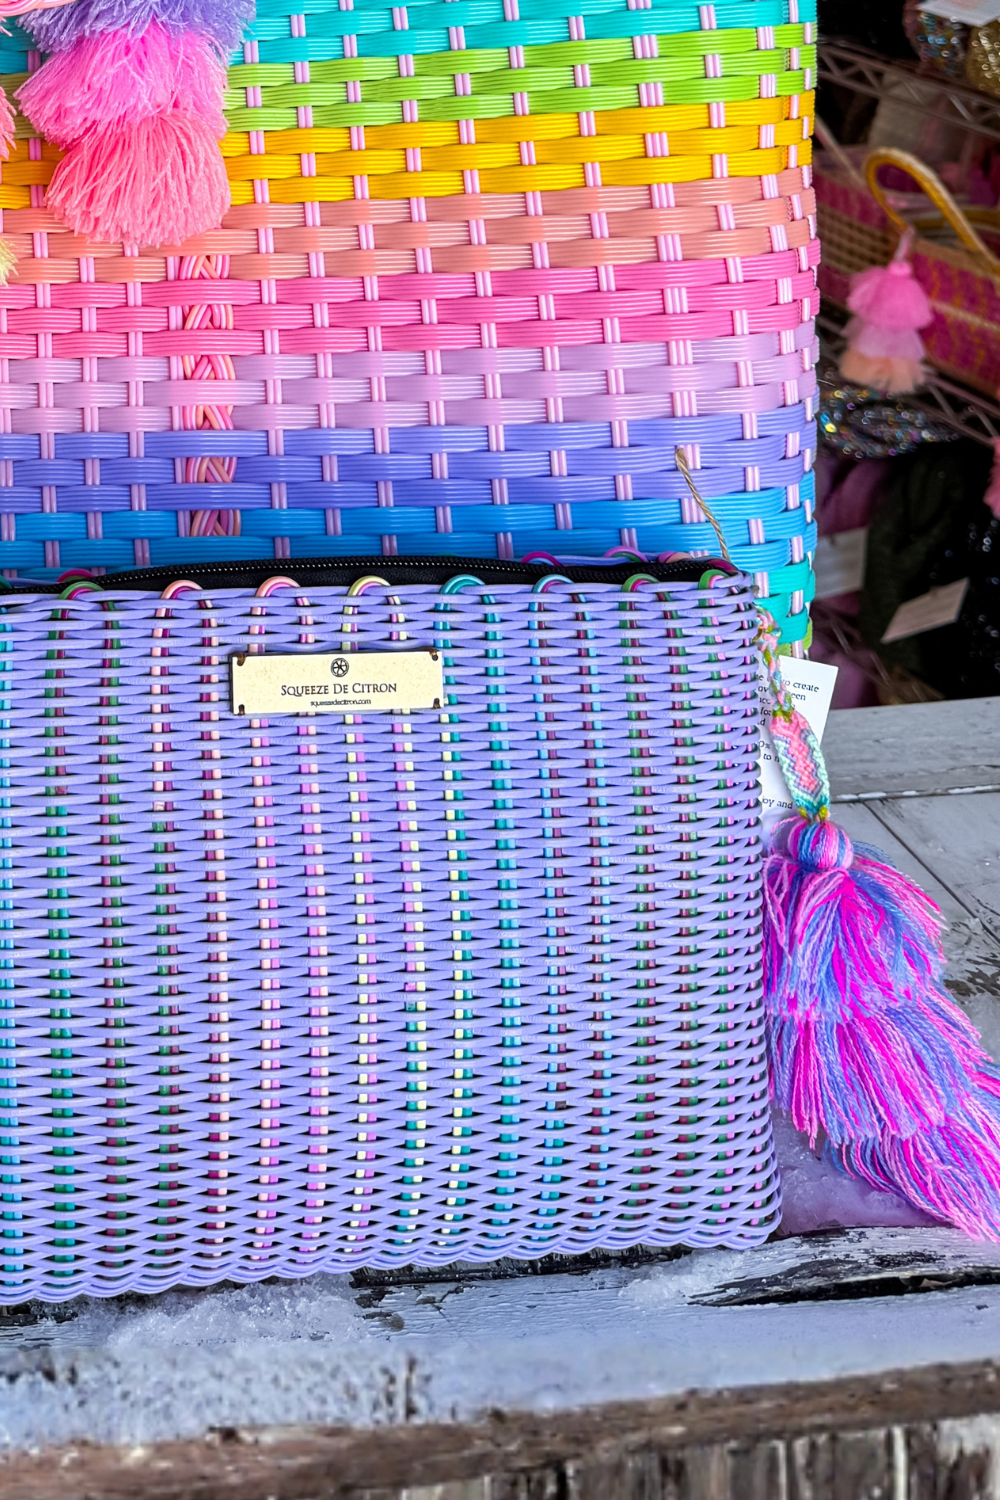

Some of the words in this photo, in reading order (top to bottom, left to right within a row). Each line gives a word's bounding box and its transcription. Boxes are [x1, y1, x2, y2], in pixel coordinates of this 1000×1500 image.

[281, 684, 329, 697] SQUEEZE
[333, 683, 349, 695] DE
[352, 682, 397, 694] CITRON
[792, 681, 820, 693] create
[776, 800, 793, 810] and
